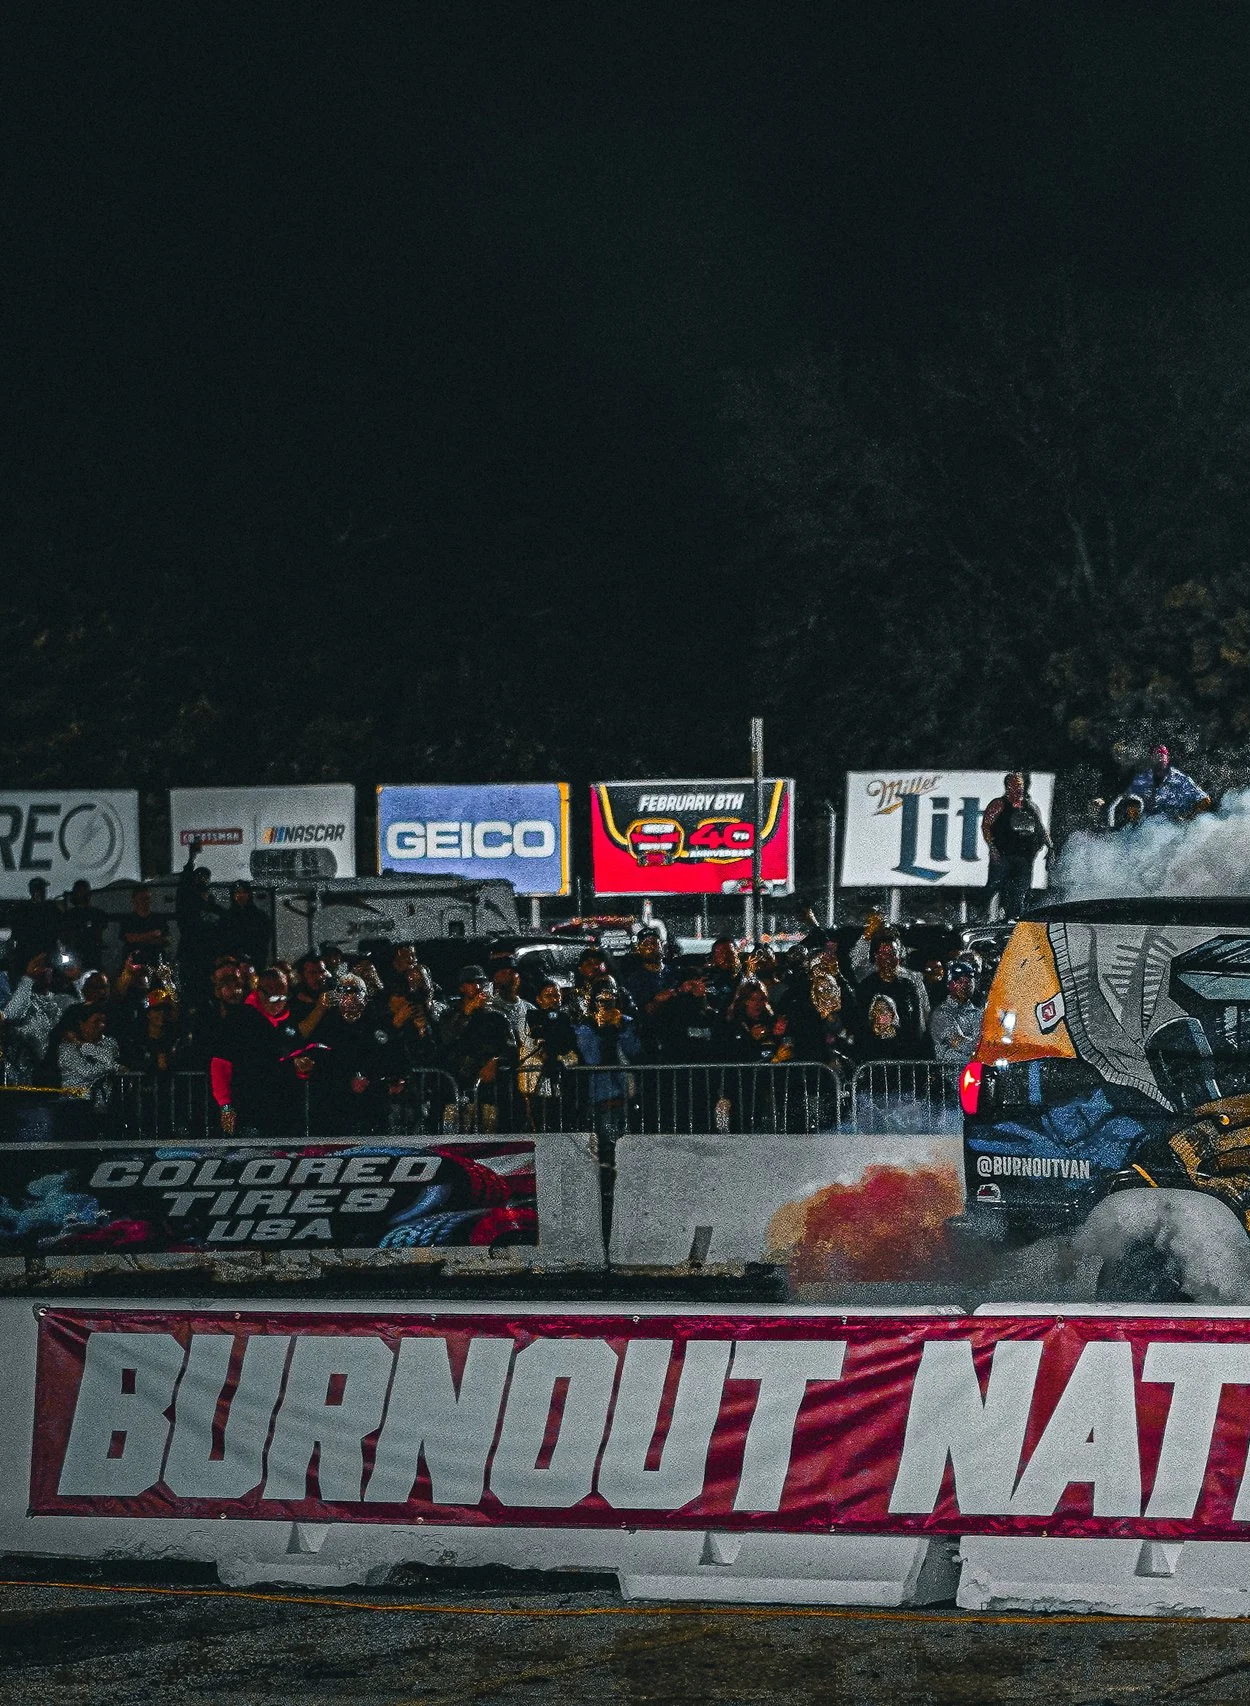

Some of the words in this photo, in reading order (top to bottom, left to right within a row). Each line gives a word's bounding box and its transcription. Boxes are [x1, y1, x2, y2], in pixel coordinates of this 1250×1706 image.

[639, 793, 715, 812] FEBRUARY
[714, 793, 745, 810] 8TH
[867, 776, 943, 810] Miller
[284, 824, 345, 842] NASCAR
[386, 821, 556, 859] GEICO
[891, 793, 985, 882] Lit
[89, 1157, 442, 1188] COLORED
[976, 1155, 1090, 1179] @BURNOUTVAN
[163, 1187, 396, 1217] TIRES
[206, 1218, 333, 1243] USA
[58, 1332, 847, 1513] BURNOUT
